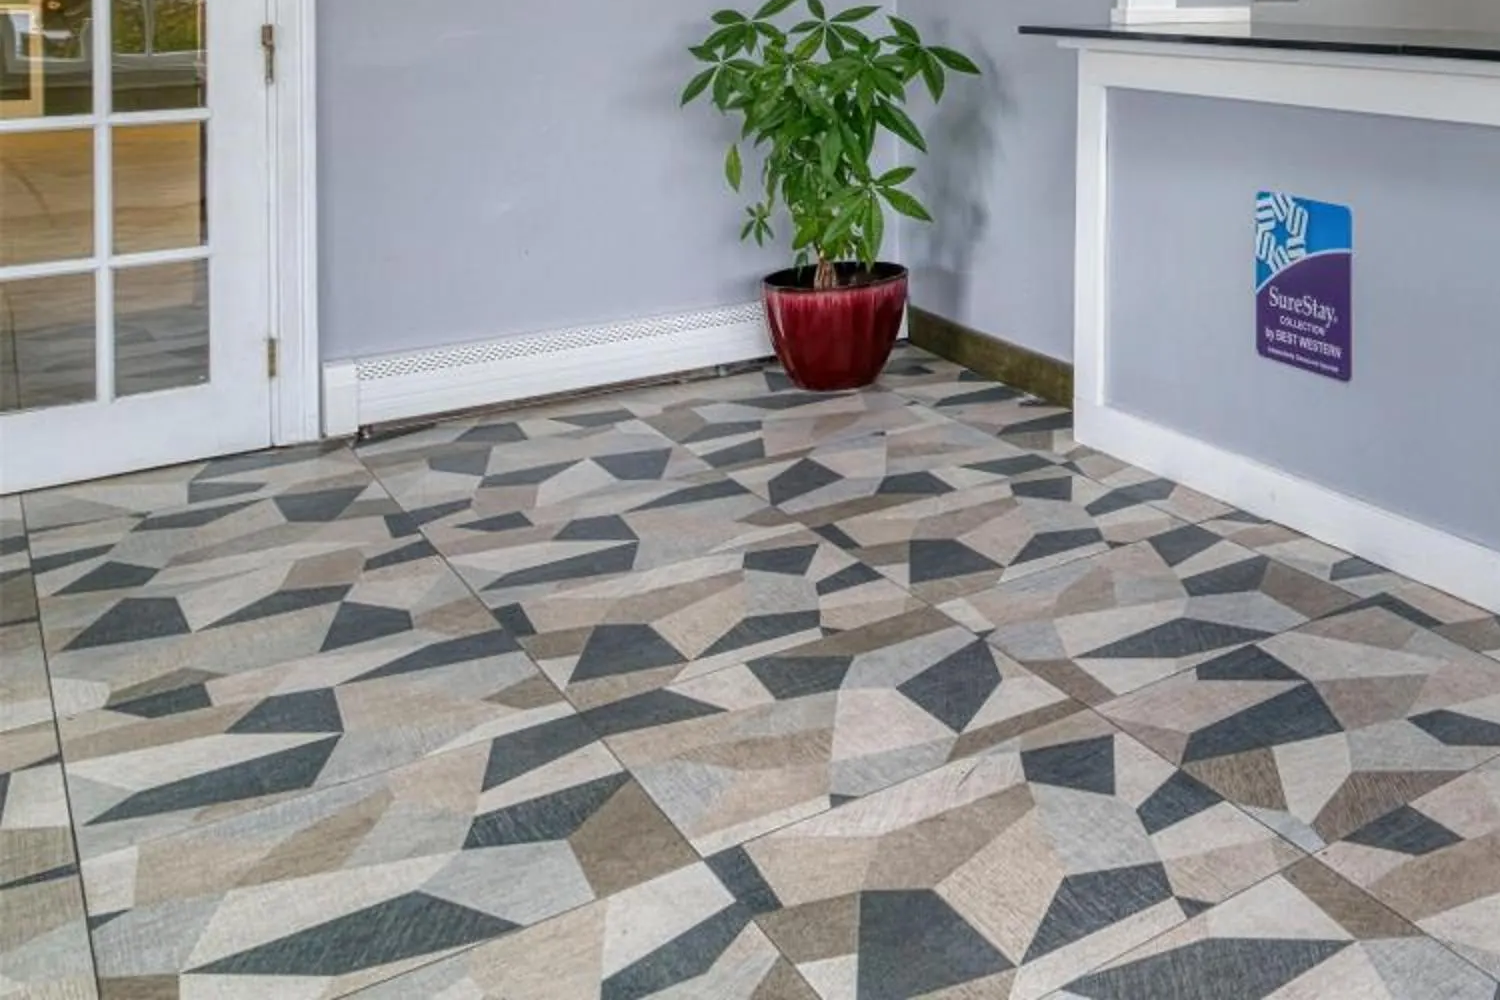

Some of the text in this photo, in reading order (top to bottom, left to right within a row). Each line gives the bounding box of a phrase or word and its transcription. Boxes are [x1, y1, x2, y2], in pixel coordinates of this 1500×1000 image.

[1280, 315, 1325, 336] COLLECTION
[1276, 329, 1297, 345] BEST
[1299, 336, 1342, 359] WESTERN
